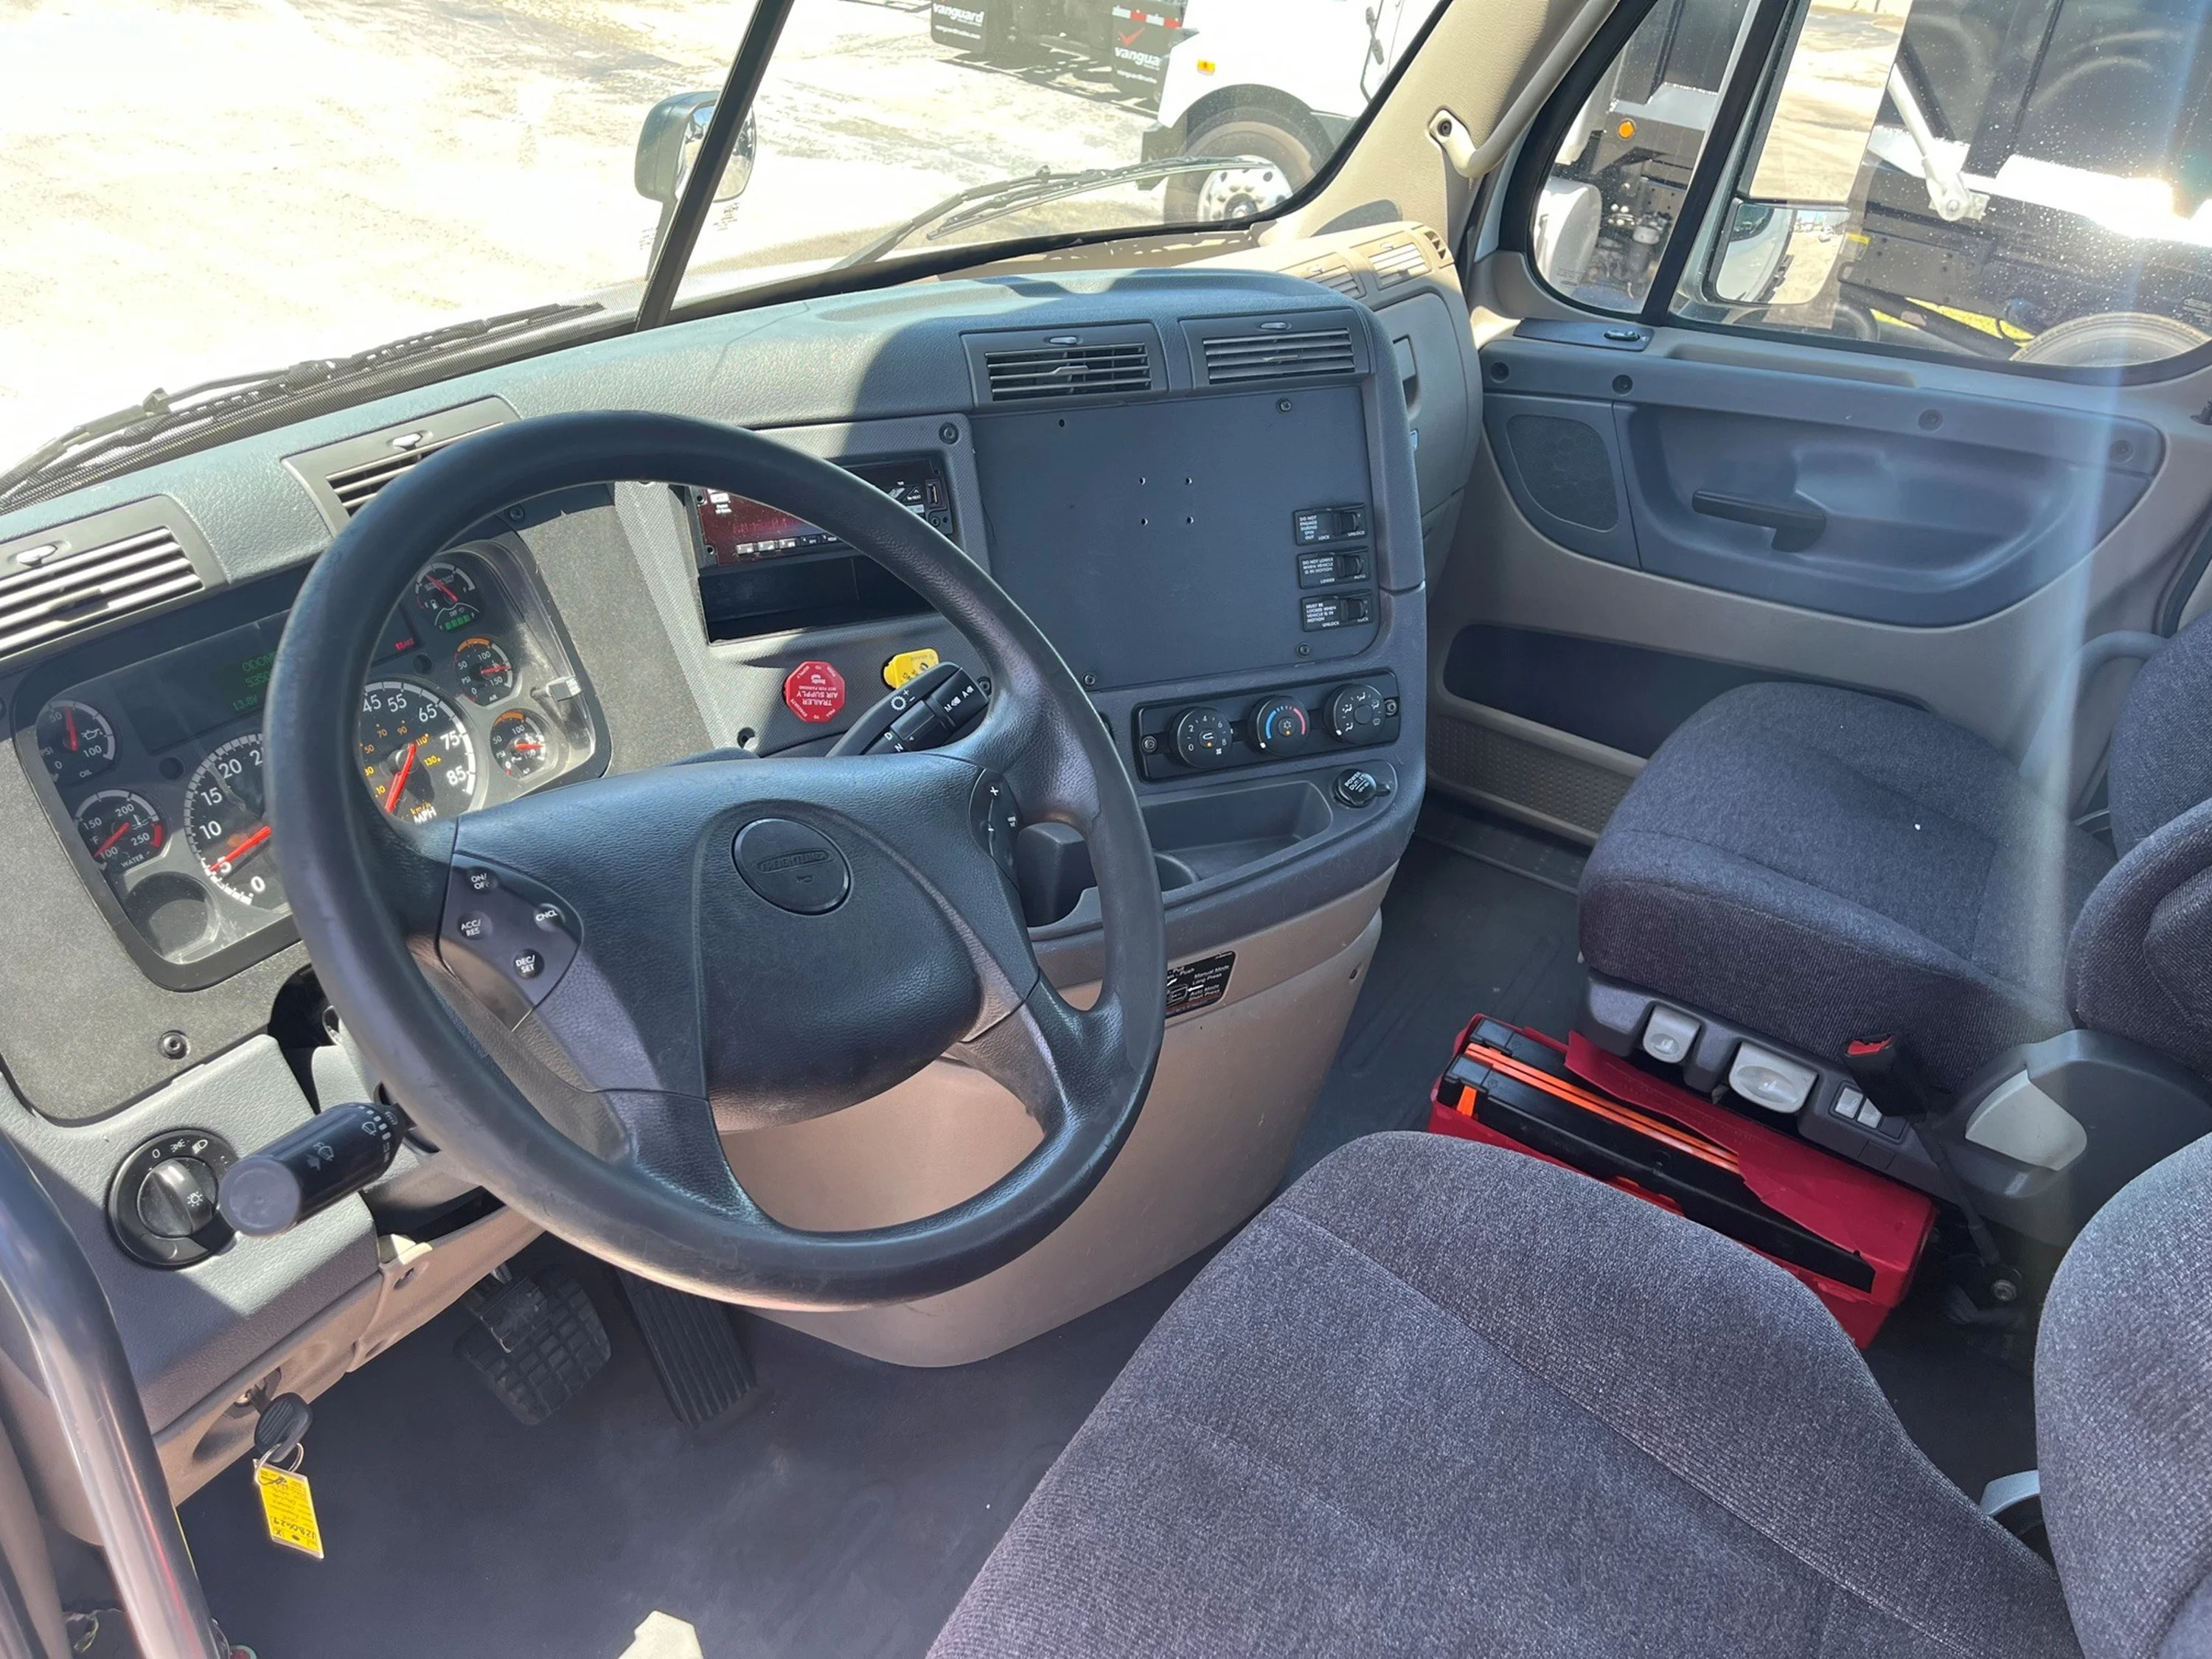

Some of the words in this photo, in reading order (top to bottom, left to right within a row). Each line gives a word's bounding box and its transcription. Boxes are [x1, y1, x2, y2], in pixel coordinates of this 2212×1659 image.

[933, 3, 984, 24] vanguard
[1114, 47, 1161, 66] vangua
[477, 650, 492, 661] 100
[457, 661, 468, 670] 50
[461, 675, 472, 685] PSI
[490, 675, 504, 687] 150
[470, 687, 477, 695] 0
[796, 690, 825, 698] SUPPLY
[961, 690, 970, 699] A
[362, 694, 382, 713] 45
[387, 693, 408, 713] 55
[801, 698, 832, 706] TRAILER
[944, 703, 953, 713] M
[49, 711, 63, 723] 50
[418, 703, 438, 723] 65
[511, 724, 526, 735] 100
[1217, 720, 1223, 728] 6
[377, 728, 388, 739] 70
[397, 726, 408, 736] 90
[884, 731, 893, 741] D
[416, 737, 428, 746] 110
[439, 730, 461, 751] 75
[493, 735, 503, 745] 50
[1222, 738, 1227, 746] 8
[83, 745, 102, 758] 100
[364, 744, 375, 754] 50
[894, 742, 904, 752] N
[1188, 743, 1194, 751] 0
[249, 747, 264, 766] 2
[495, 750, 507, 759] PSI
[524, 749, 537, 759] 150
[54, 760, 63, 771] 0
[423, 755, 438, 767] 130
[505, 760, 512, 769] 0
[79, 769, 93, 778] OIL
[218, 758, 243, 779] 20
[364, 765, 375, 776] 30
[446, 765, 467, 786] 85
[1344, 771, 1362, 787] POWER
[1349, 774, 1367, 791] OUTLET
[375, 785, 386, 795] 10
[201, 787, 223, 807] 15
[114, 803, 135, 818] 200
[410, 801, 432, 815] km/h
[413, 806, 437, 824] MPH
[83, 816, 102, 830] 150
[199, 820, 222, 840] 10
[131, 832, 151, 846] 250
[100, 846, 119, 860] 100
[120, 853, 145, 869] WATER
[217, 855, 232, 874] 5
[470, 872, 487, 884] ON/
[250, 875, 266, 894] 0
[535, 909, 558, 922] CNCL
[460, 919, 482, 931] ACC/
[465, 927, 480, 937] RES
[515, 954, 536, 967] DEC/
[521, 963, 535, 973] SET
[1194, 969, 1214, 978] Manual
[1214, 964, 1230, 973] Mode
[1192, 978, 1206, 986] Long
